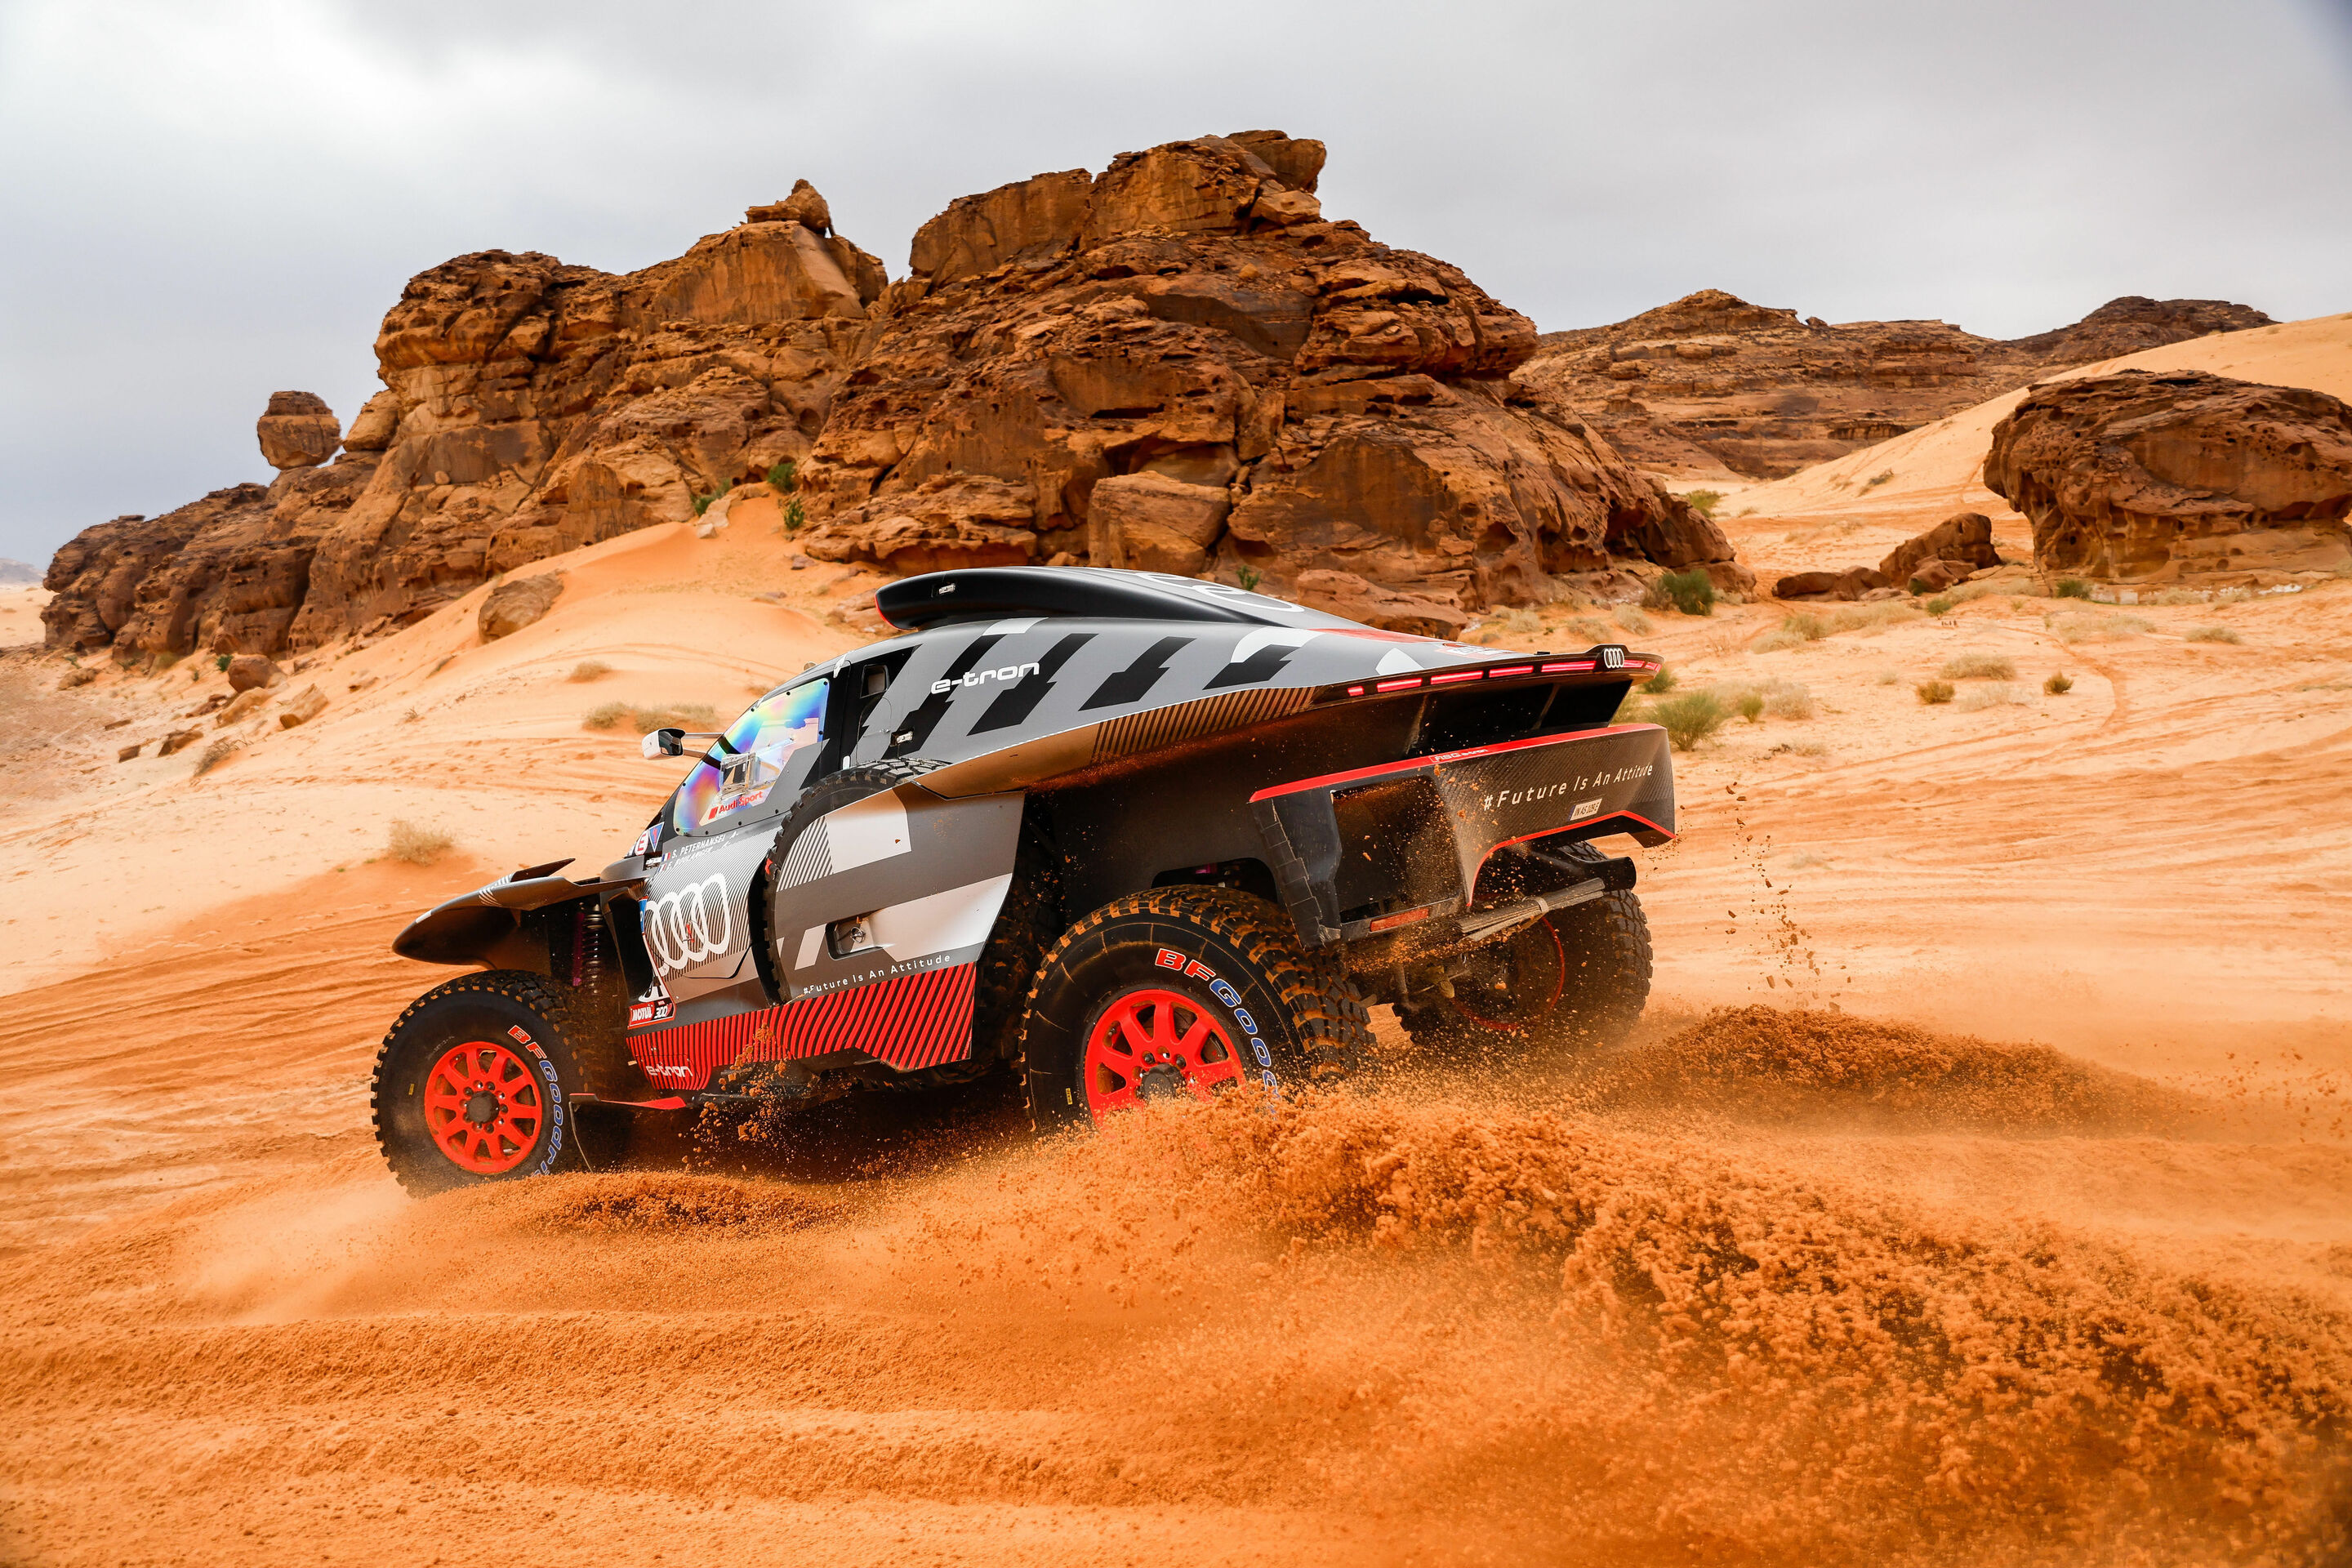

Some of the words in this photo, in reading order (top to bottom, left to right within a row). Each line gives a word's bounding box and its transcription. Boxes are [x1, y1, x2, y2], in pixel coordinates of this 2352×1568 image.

[930, 662, 1040, 694] e-tron
[1483, 782, 1567, 811] #Future
[1573, 776, 1588, 791] Is
[1592, 771, 1610, 787] An
[1613, 762, 1653, 782] Attitude
[719, 799, 738, 813] Audi
[738, 791, 764, 807] Sport
[671, 849, 678, 859] S.
[679, 833, 726, 856] PETERHANSEL
[853, 974, 863, 983] Is
[869, 969, 884, 979] An
[890, 954, 951, 974] Attitude
[632, 1006, 653, 1022] MOTUL
[645, 1063, 693, 1077] e-tron
